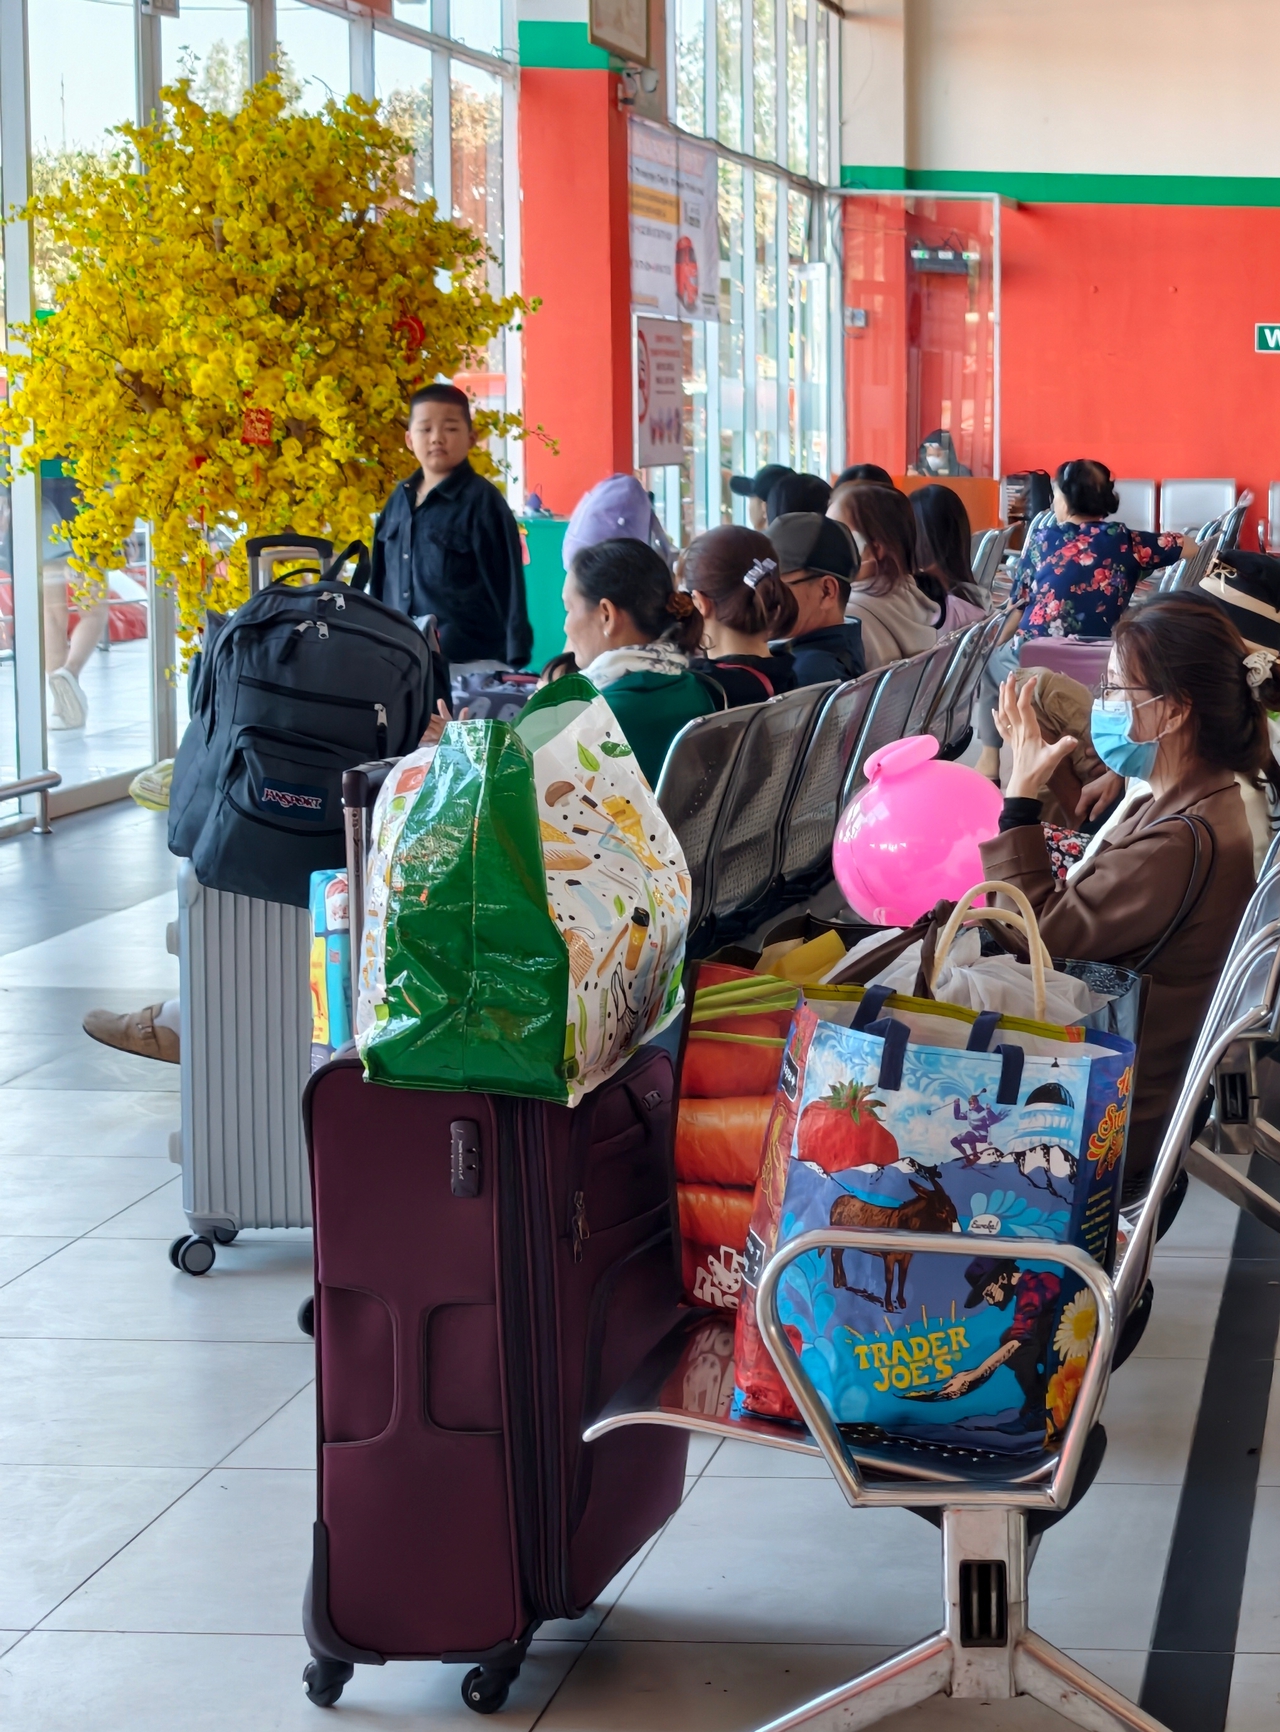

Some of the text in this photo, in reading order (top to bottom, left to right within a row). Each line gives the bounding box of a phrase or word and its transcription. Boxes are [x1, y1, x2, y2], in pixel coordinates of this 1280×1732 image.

[971, 1220, 998, 1233] Eureka!
[854, 1327, 970, 1369] TRADER
[873, 1354, 954, 1391] JOE'S
